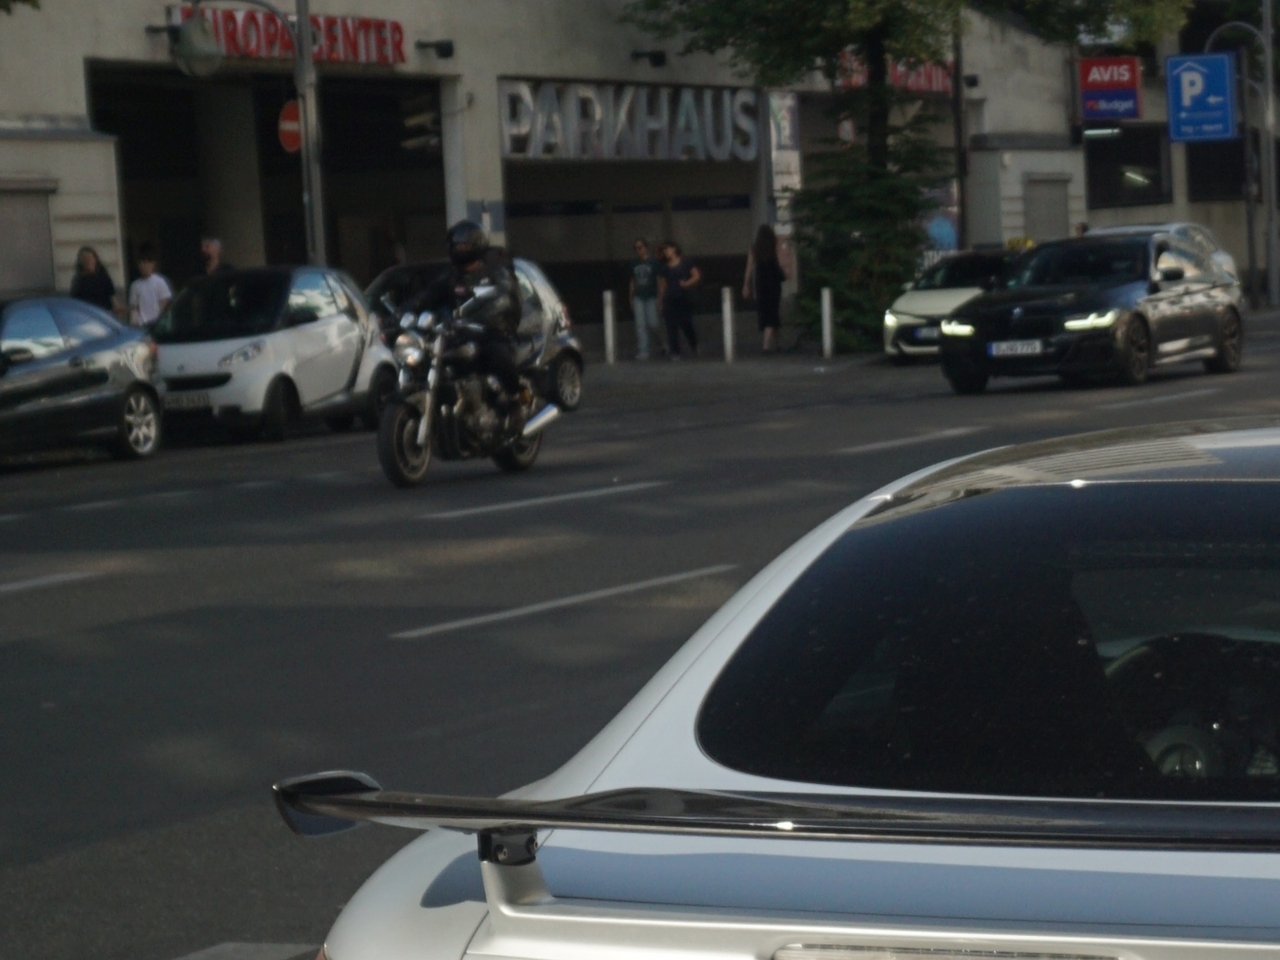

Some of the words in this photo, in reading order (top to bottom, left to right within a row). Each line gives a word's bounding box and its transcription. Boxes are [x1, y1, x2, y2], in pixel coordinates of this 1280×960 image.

[1087, 65, 1130, 83] AVIS
[1181, 70, 1203, 107] P
[500, 83, 759, 161] PARKHAUS
